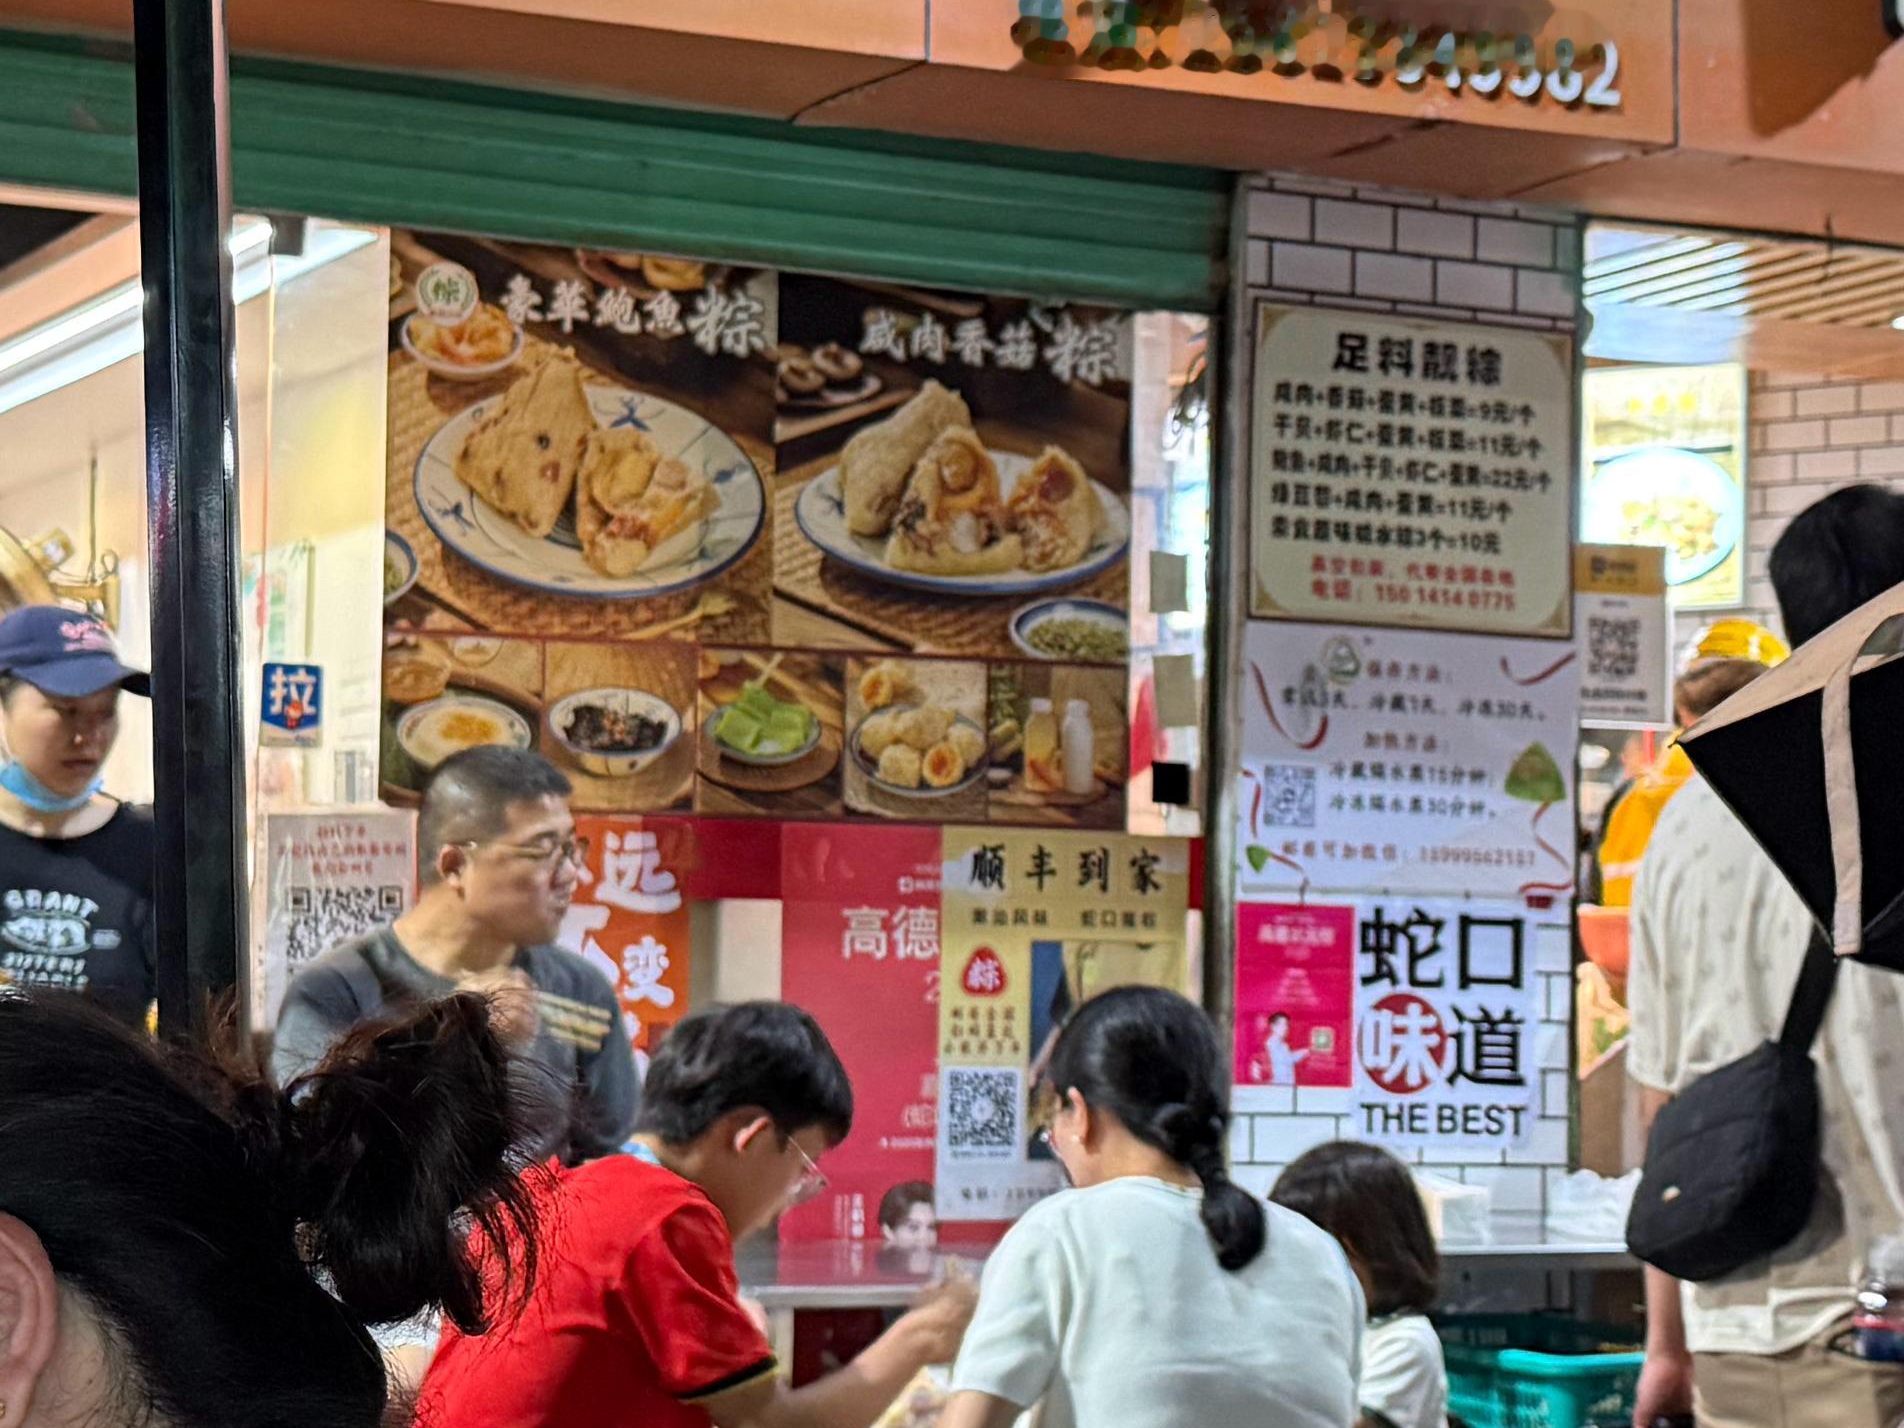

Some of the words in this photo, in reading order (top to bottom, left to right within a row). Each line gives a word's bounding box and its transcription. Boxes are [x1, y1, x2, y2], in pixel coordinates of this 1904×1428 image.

[269, 666, 317, 718] 拉
[1360, 907, 1525, 989] 蛇口
[1362, 999, 1526, 1088] 味道
[1361, 1102, 1430, 1135] THE
[1436, 1104, 1529, 1136] BEST
